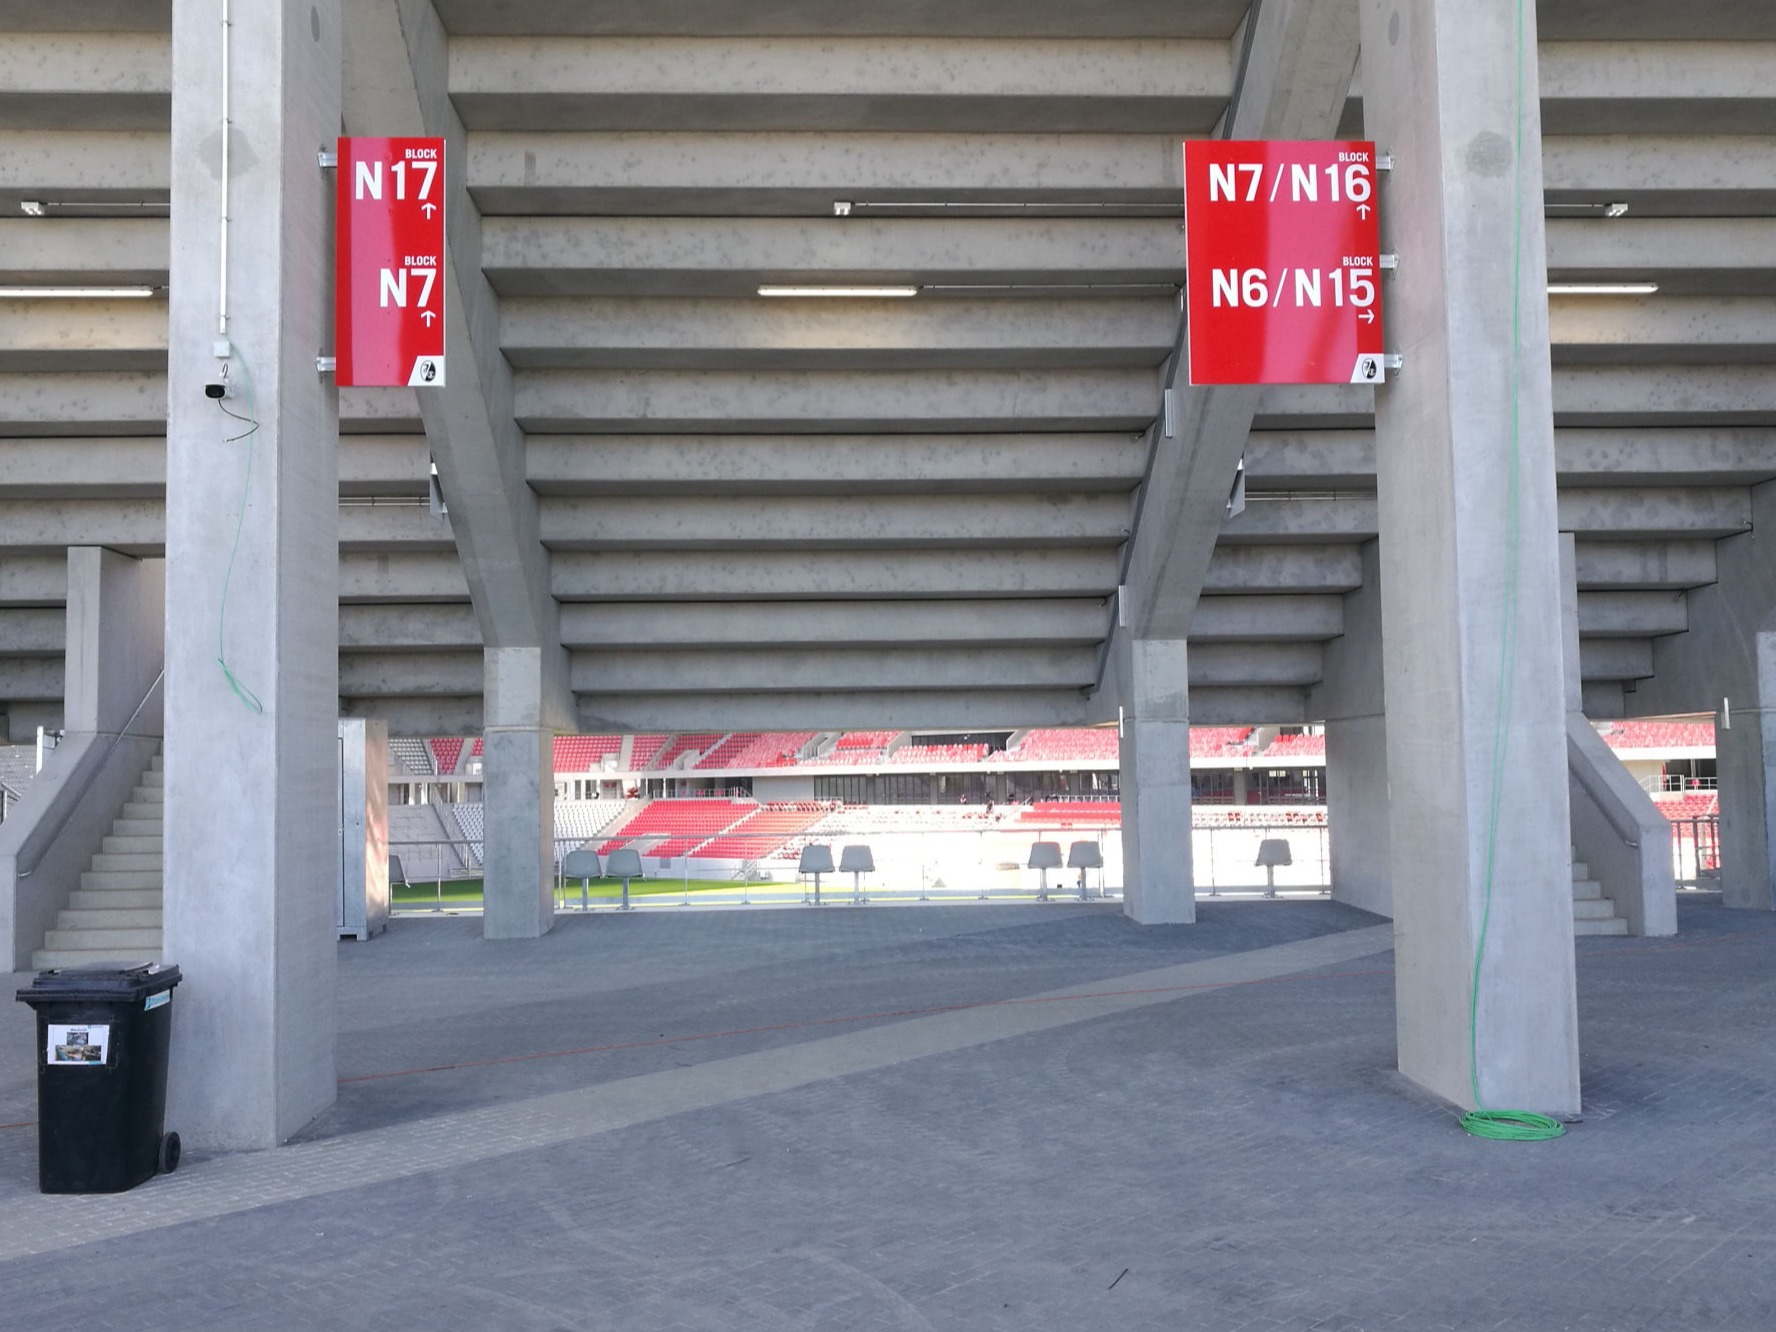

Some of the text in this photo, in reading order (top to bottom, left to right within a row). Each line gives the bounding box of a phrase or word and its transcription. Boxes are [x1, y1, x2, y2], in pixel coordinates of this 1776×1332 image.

[405, 149, 437, 159] BLOCK
[1338, 152, 1369, 162] BLOCK
[355, 161, 438, 200] N17
[404, 256, 437, 266] BLOCK
[1342, 256, 1373, 266] BLOCK
[379, 268, 437, 308] N7
